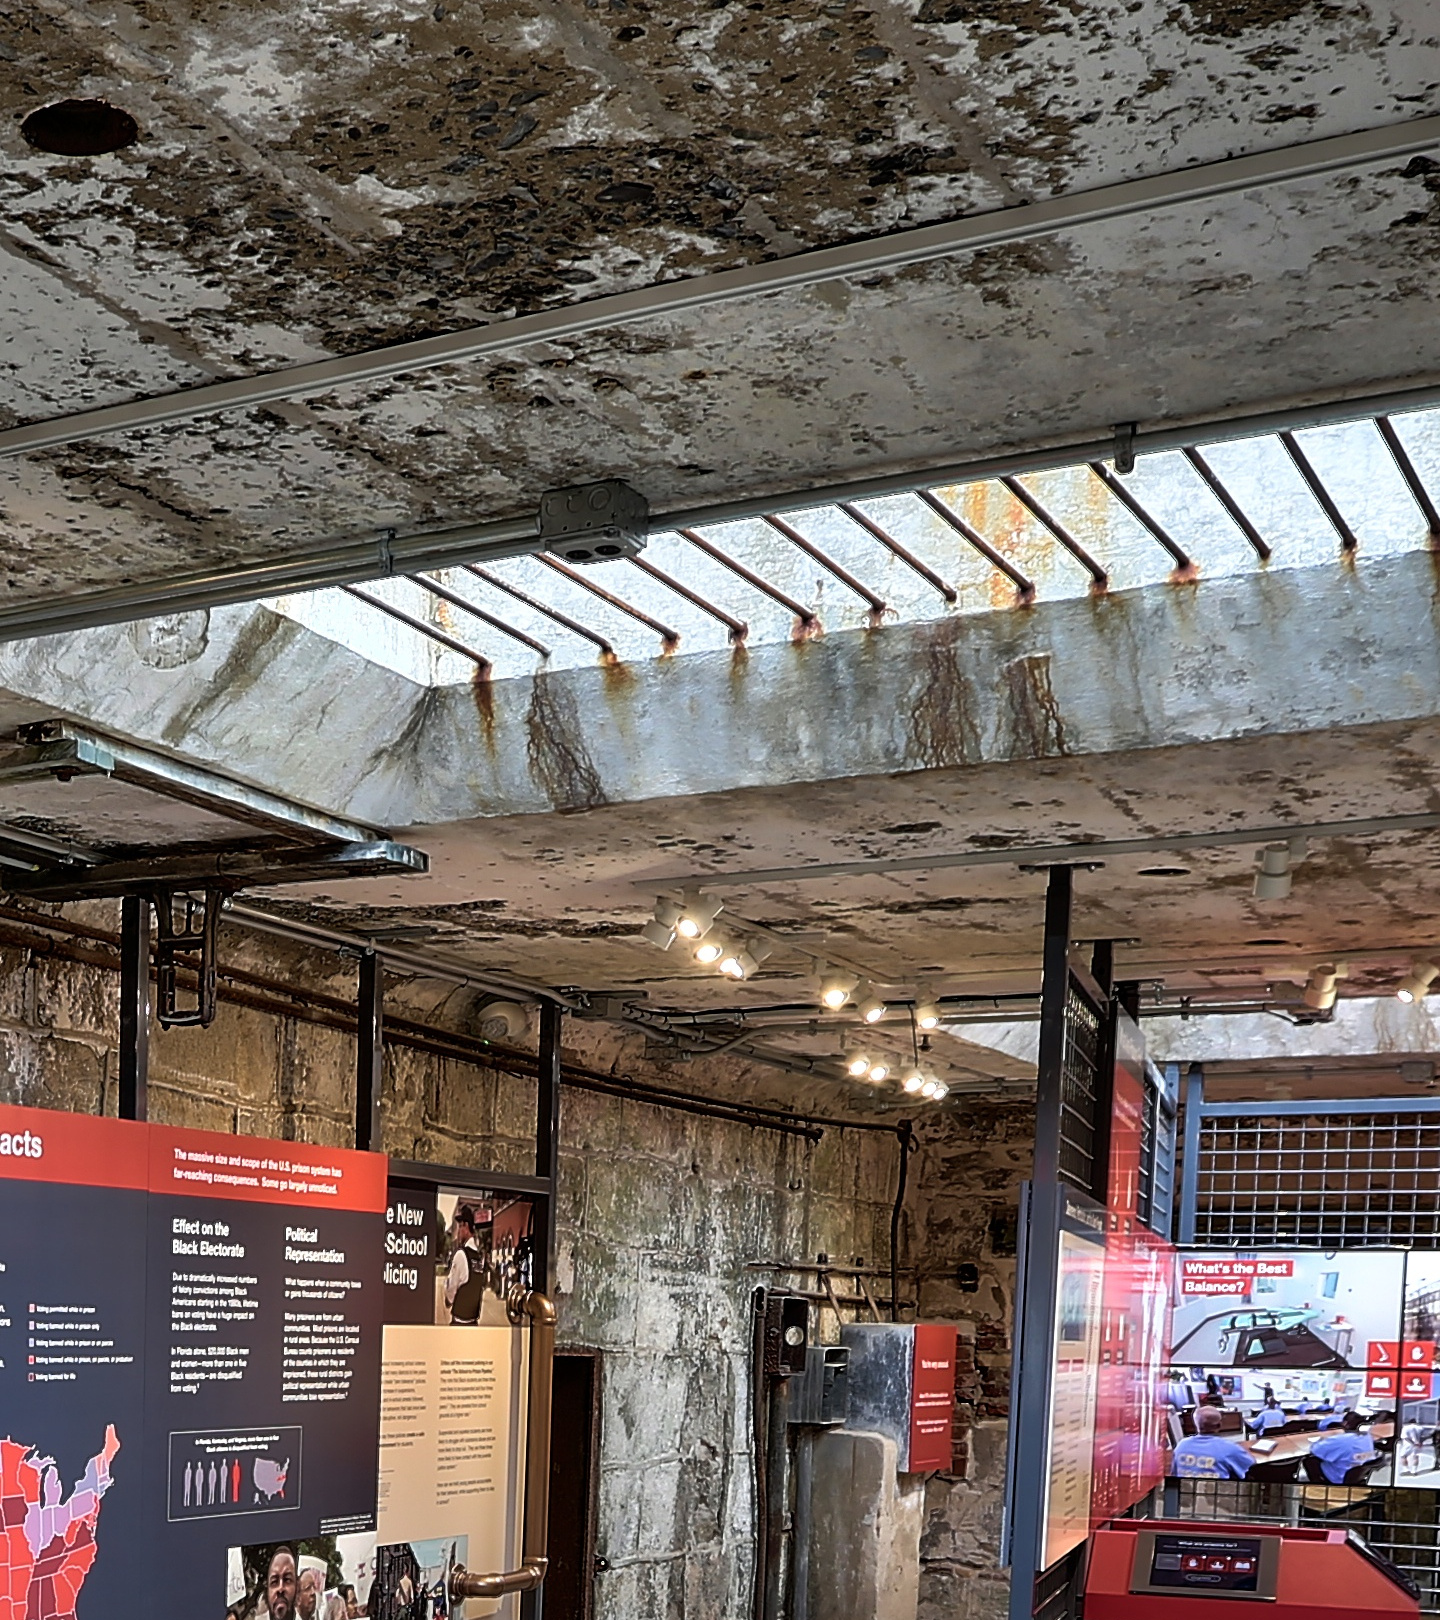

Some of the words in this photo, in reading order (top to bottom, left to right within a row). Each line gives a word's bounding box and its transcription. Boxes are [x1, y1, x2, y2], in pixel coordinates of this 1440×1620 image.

[174, 1148, 187, 1160] The
[188, 1151, 214, 1164] massive
[214, 1153, 228, 1165] size
[228, 1156, 241, 1166] and
[241, 1158, 260, 1170] scope
[260, 1158, 268, 1169] of
[268, 1160, 278, 1170] the
[278, 1160, 291, 1172] U.S.
[291, 1162, 310, 1174] prison
[310, 1166, 331, 1177] system
[331, 1166, 342, 1178] has
[173, 1167, 213, 1184] far-reaching
[213, 1173, 260, 1186] consequences.
[262, 1176, 280, 1188] Some
[280, 1180, 288, 1192] go
[288, 1179, 308, 1194] largely
[308, 1183, 338, 1194] unnoticed.
[397, 1203, 424, 1226] New
[172, 1218, 200, 1235] Effect
[201, 1224, 214, 1236] on
[214, 1221, 230, 1237] the
[286, 1226, 318, 1243] Political
[172, 1238, 198, 1255] Black
[200, 1240, 244, 1258] Electorate
[284, 1246, 344, 1264] Representation
[1185, 1262, 1230, 1274] What's
[1232, 1262, 1254, 1274] the
[1256, 1262, 1288, 1274] Best
[1184, 1281, 1245, 1292] Balance?
